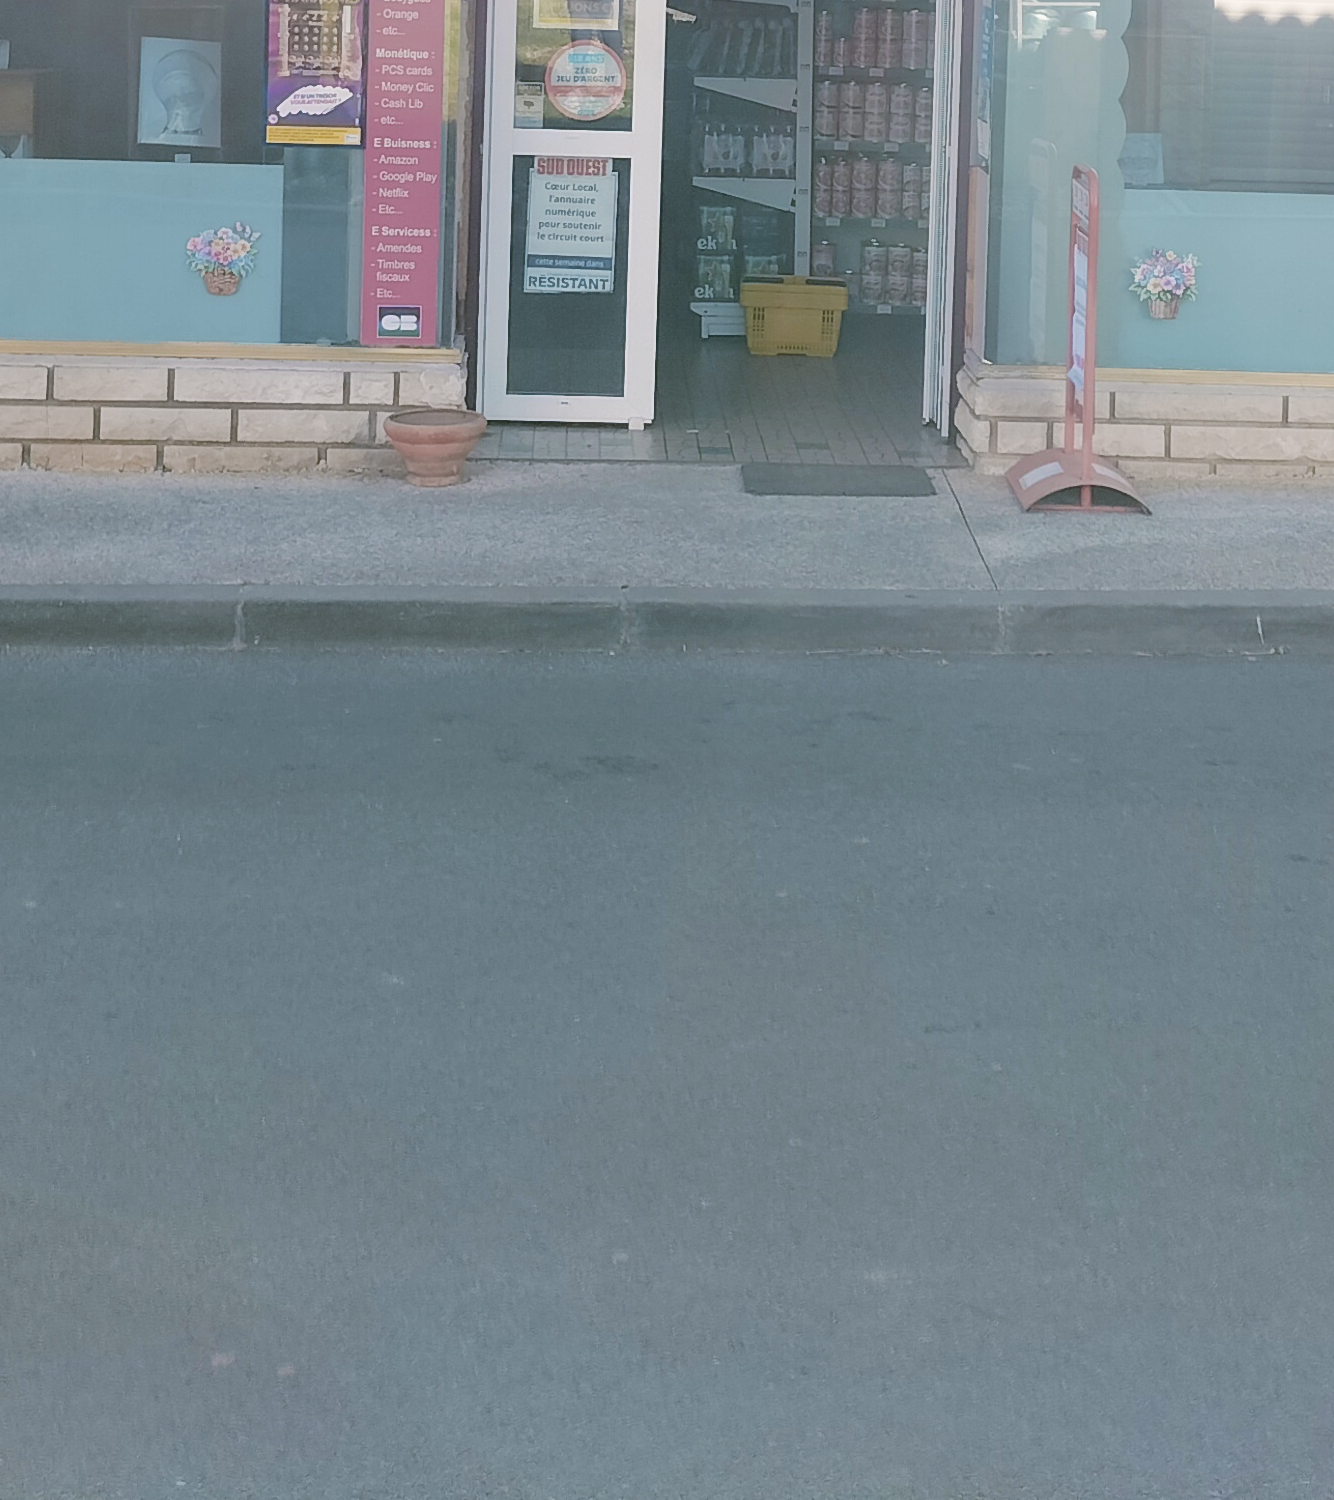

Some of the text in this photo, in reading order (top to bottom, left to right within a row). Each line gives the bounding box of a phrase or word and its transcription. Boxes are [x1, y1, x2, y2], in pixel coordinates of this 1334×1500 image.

[383, 8, 419, 21] Orange
[376, 48, 429, 60] Monétique
[381, 64, 404, 75] PCS
[406, 66, 433, 76] cards
[574, 66, 598, 74] ZÉRO
[556, 75, 616, 83] JEU D'ARGENT
[381, 82, 414, 94] Money
[416, 82, 434, 92] Clic
[381, 98, 406, 108] Cash
[408, 99, 423, 108] Lib
[373, 137, 382, 148] E
[383, 137, 431, 149] Buisness
[378, 154, 419, 165] Amazon
[537, 157, 609, 177] SUD OUEST
[379, 171, 414, 183] Google
[416, 171, 438, 184] Play
[378, 187, 409, 198] Netflix
[544, 182, 599, 193] Cœur Local,
[548, 194, 596, 204] l'annuaire
[545, 208, 597, 219] numérique
[538, 221, 602, 230] pour soutenir
[371, 226, 379, 236] E
[381, 226, 431, 237] Servicess
[537, 232, 546, 240] le
[547, 232, 577, 241] circuit
[376, 242, 422, 253] Amendes
[377, 259, 416, 270] Timbres
[535, 258, 604, 268] cette semaine dans
[376, 271, 410, 282] fiscaux
[528, 274, 609, 290] RÉSISTANT
